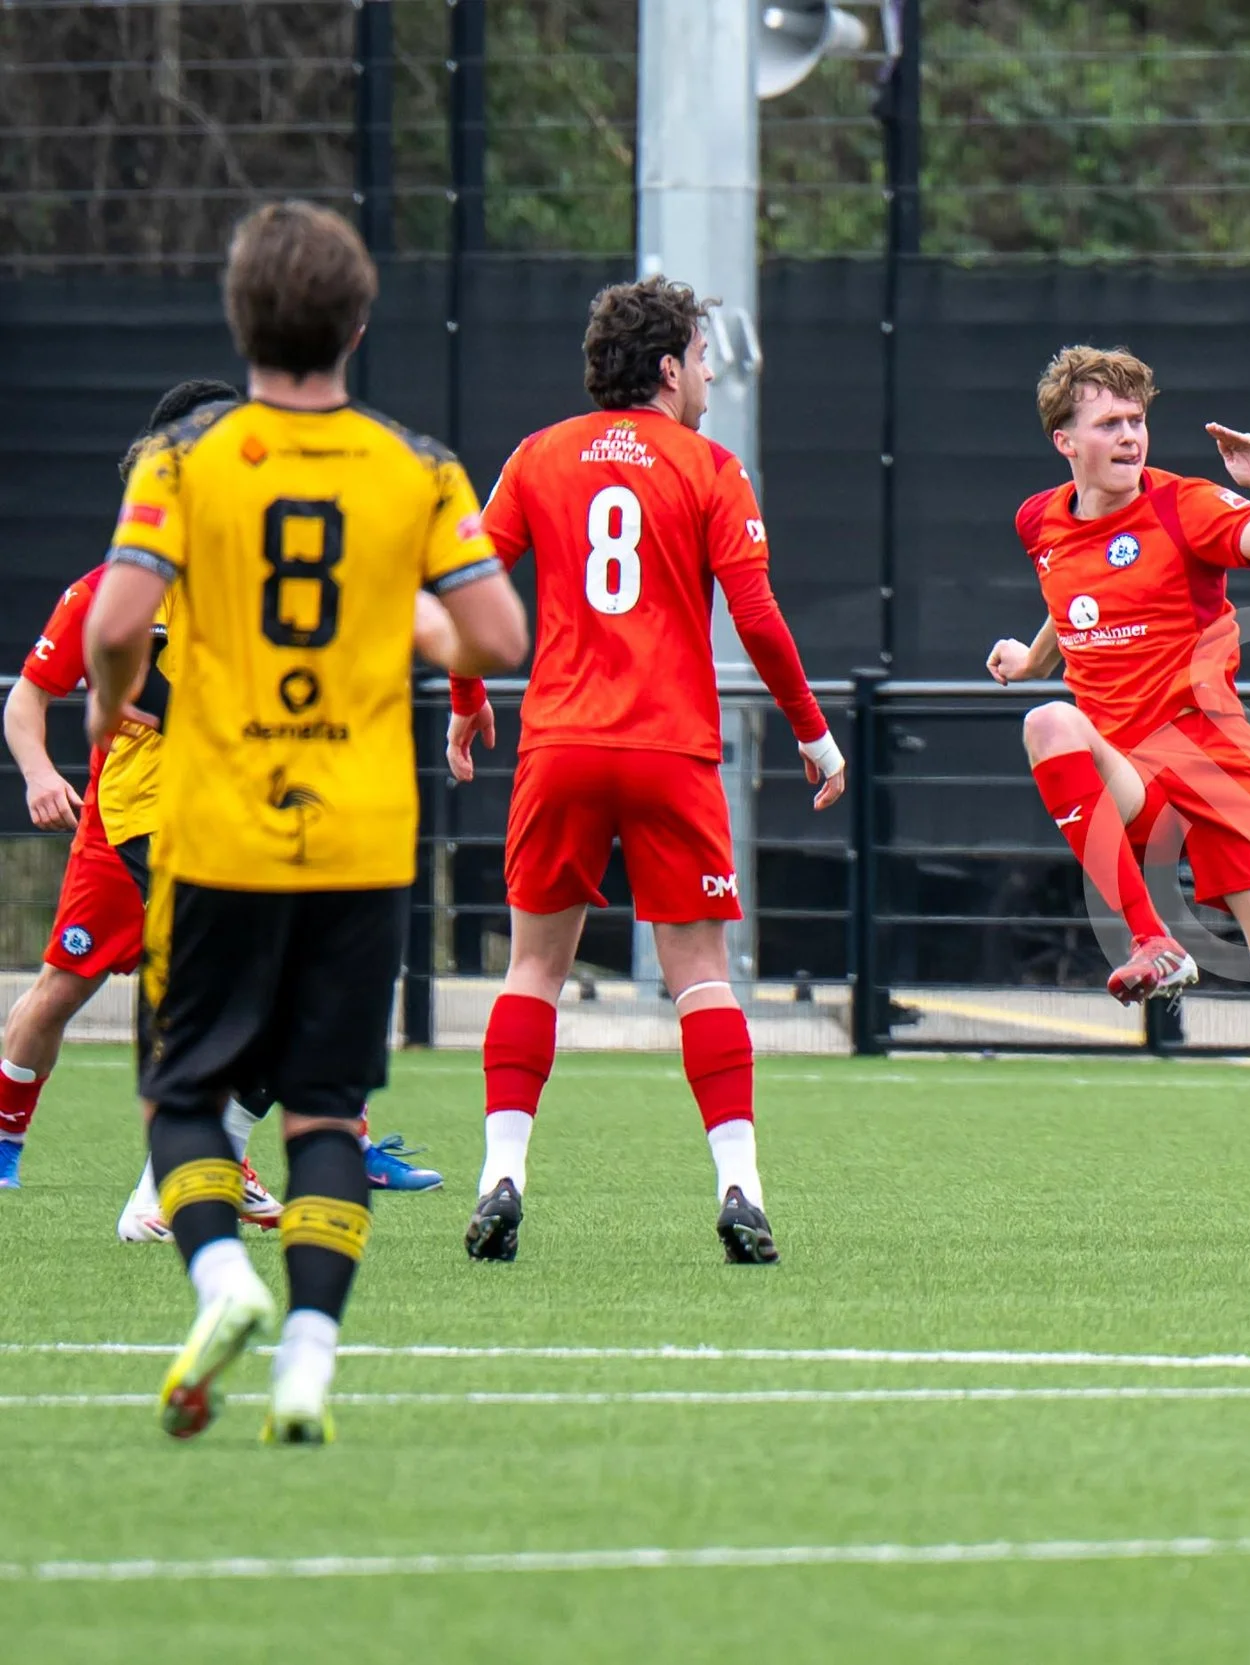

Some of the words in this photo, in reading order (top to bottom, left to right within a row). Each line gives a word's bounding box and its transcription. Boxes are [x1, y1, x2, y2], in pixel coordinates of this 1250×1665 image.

[605, 428, 636, 442] THE
[591, 438, 647, 456] CROWN
[580, 449, 657, 468] BILLERICAY
[585, 485, 642, 615] 8
[262, 496, 345, 648] 8
[1090, 624, 1149, 641] Skinner
